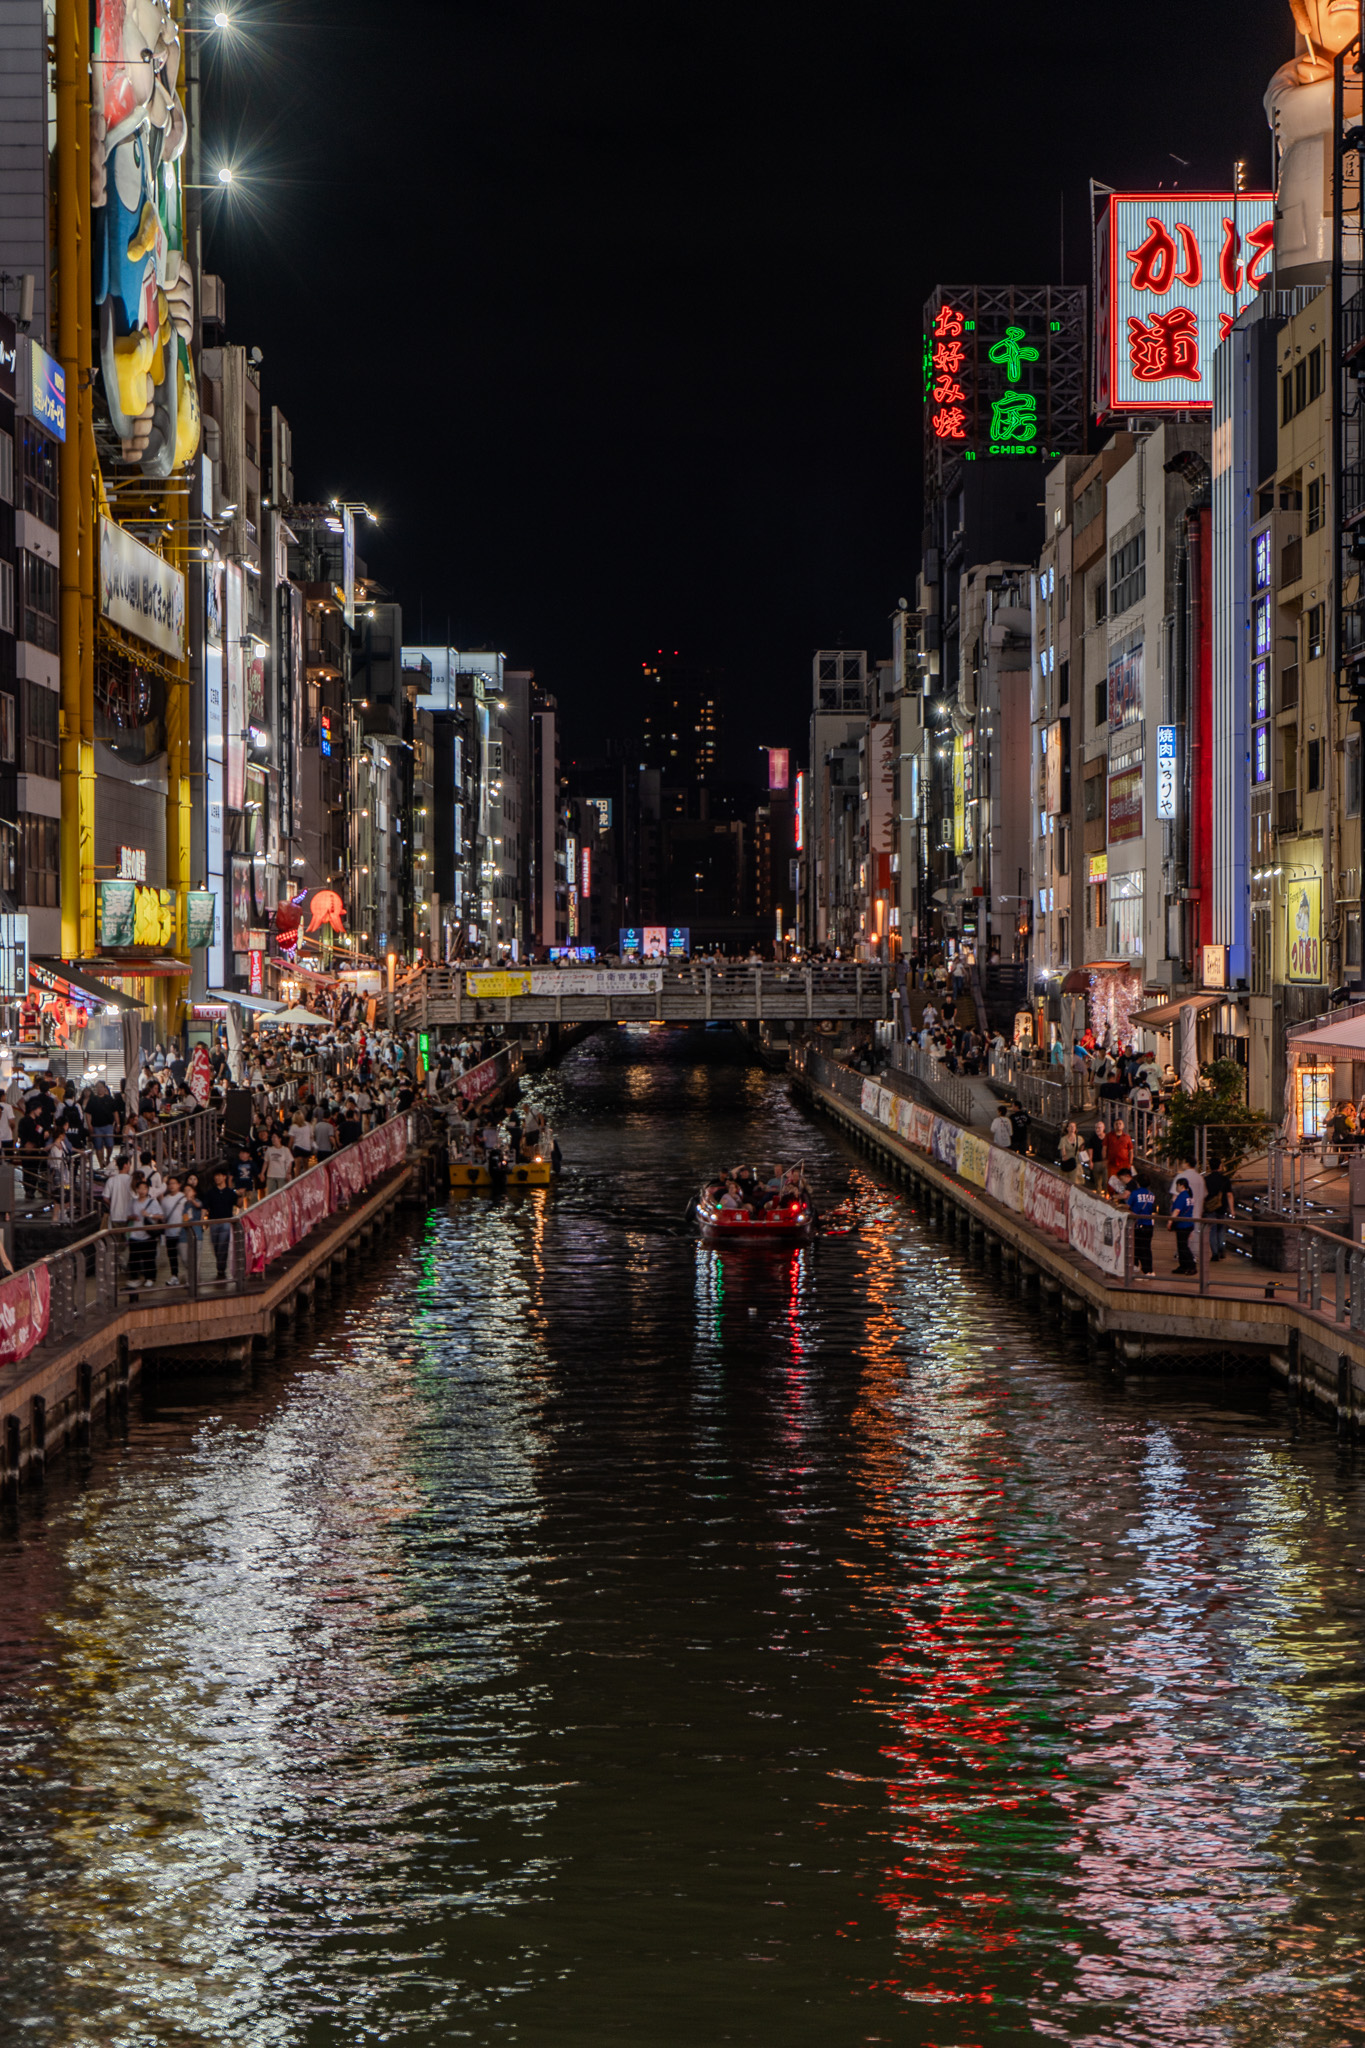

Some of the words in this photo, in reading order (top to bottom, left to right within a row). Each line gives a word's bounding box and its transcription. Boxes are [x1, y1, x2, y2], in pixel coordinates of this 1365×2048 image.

[931, 305, 967, 438] お好み焼
[1127, 305, 1246, 382] 道
[988, 326, 1039, 442] 千房
[989, 444, 1037, 455] CHIBO
[1159, 728, 1174, 757] 焼肉
[1160, 760, 1173, 816] いろりや
